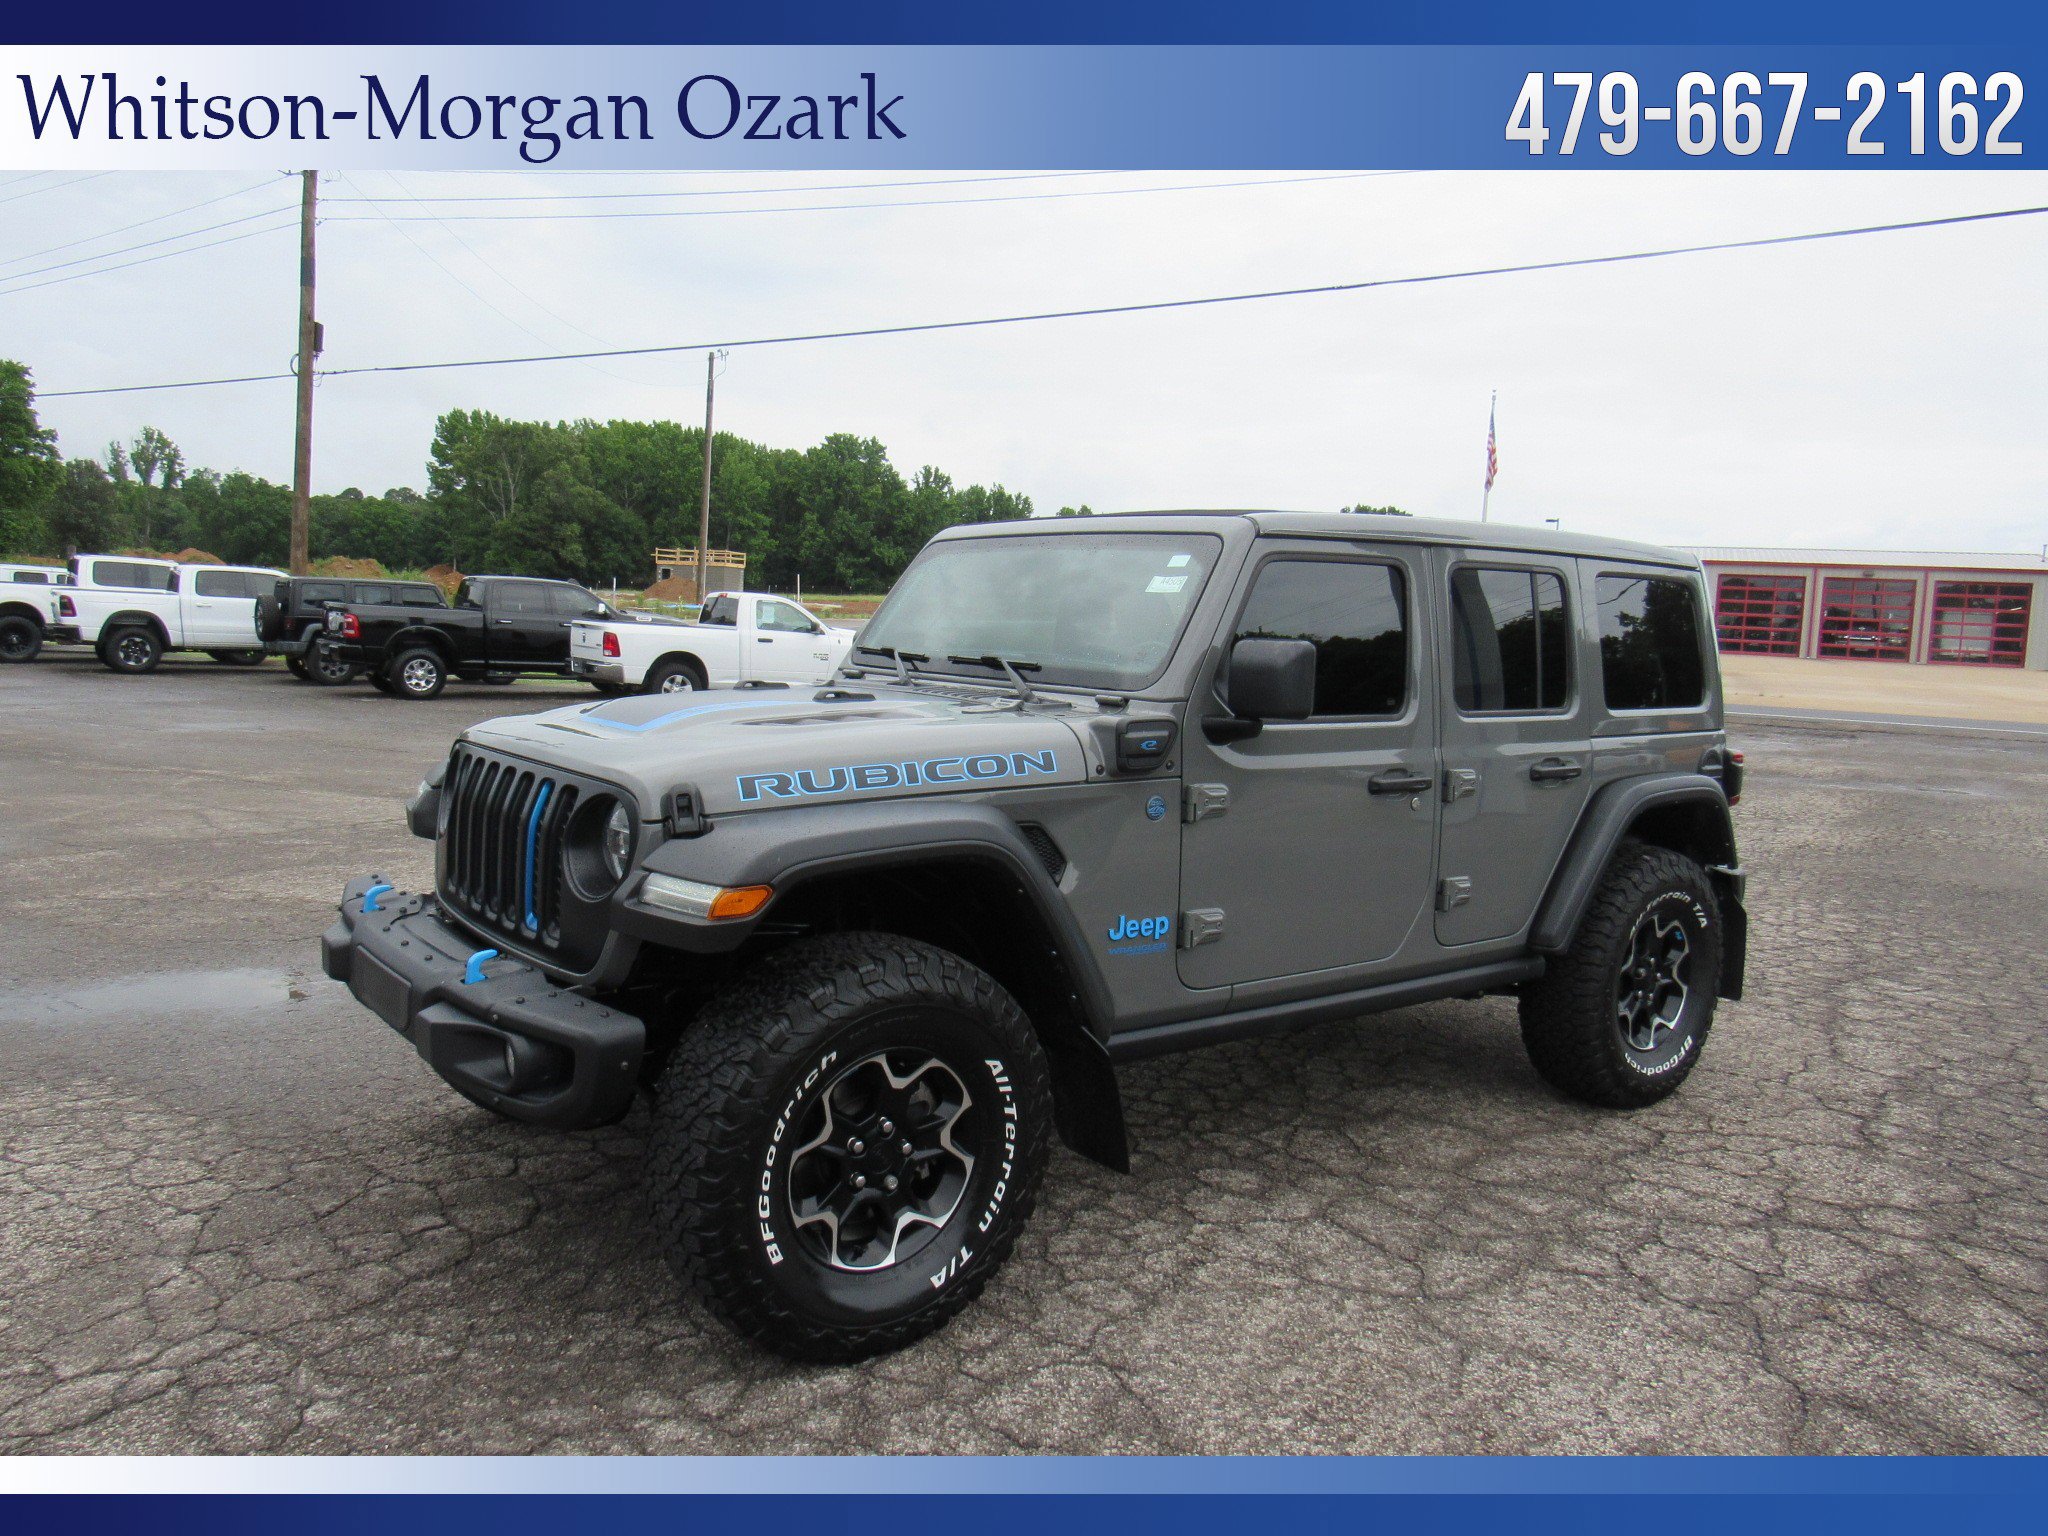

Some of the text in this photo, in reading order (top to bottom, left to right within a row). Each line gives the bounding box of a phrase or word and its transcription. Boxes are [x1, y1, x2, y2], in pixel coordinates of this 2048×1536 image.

[736, 750, 1057, 801] RUBICON
[1108, 913, 1169, 941] Jeep
[1624, 1034, 1693, 1076] BFGoodrich
[758, 1050, 838, 1266] BFGoodrich
[929, 1058, 1018, 1289] All-Terrain T/A
